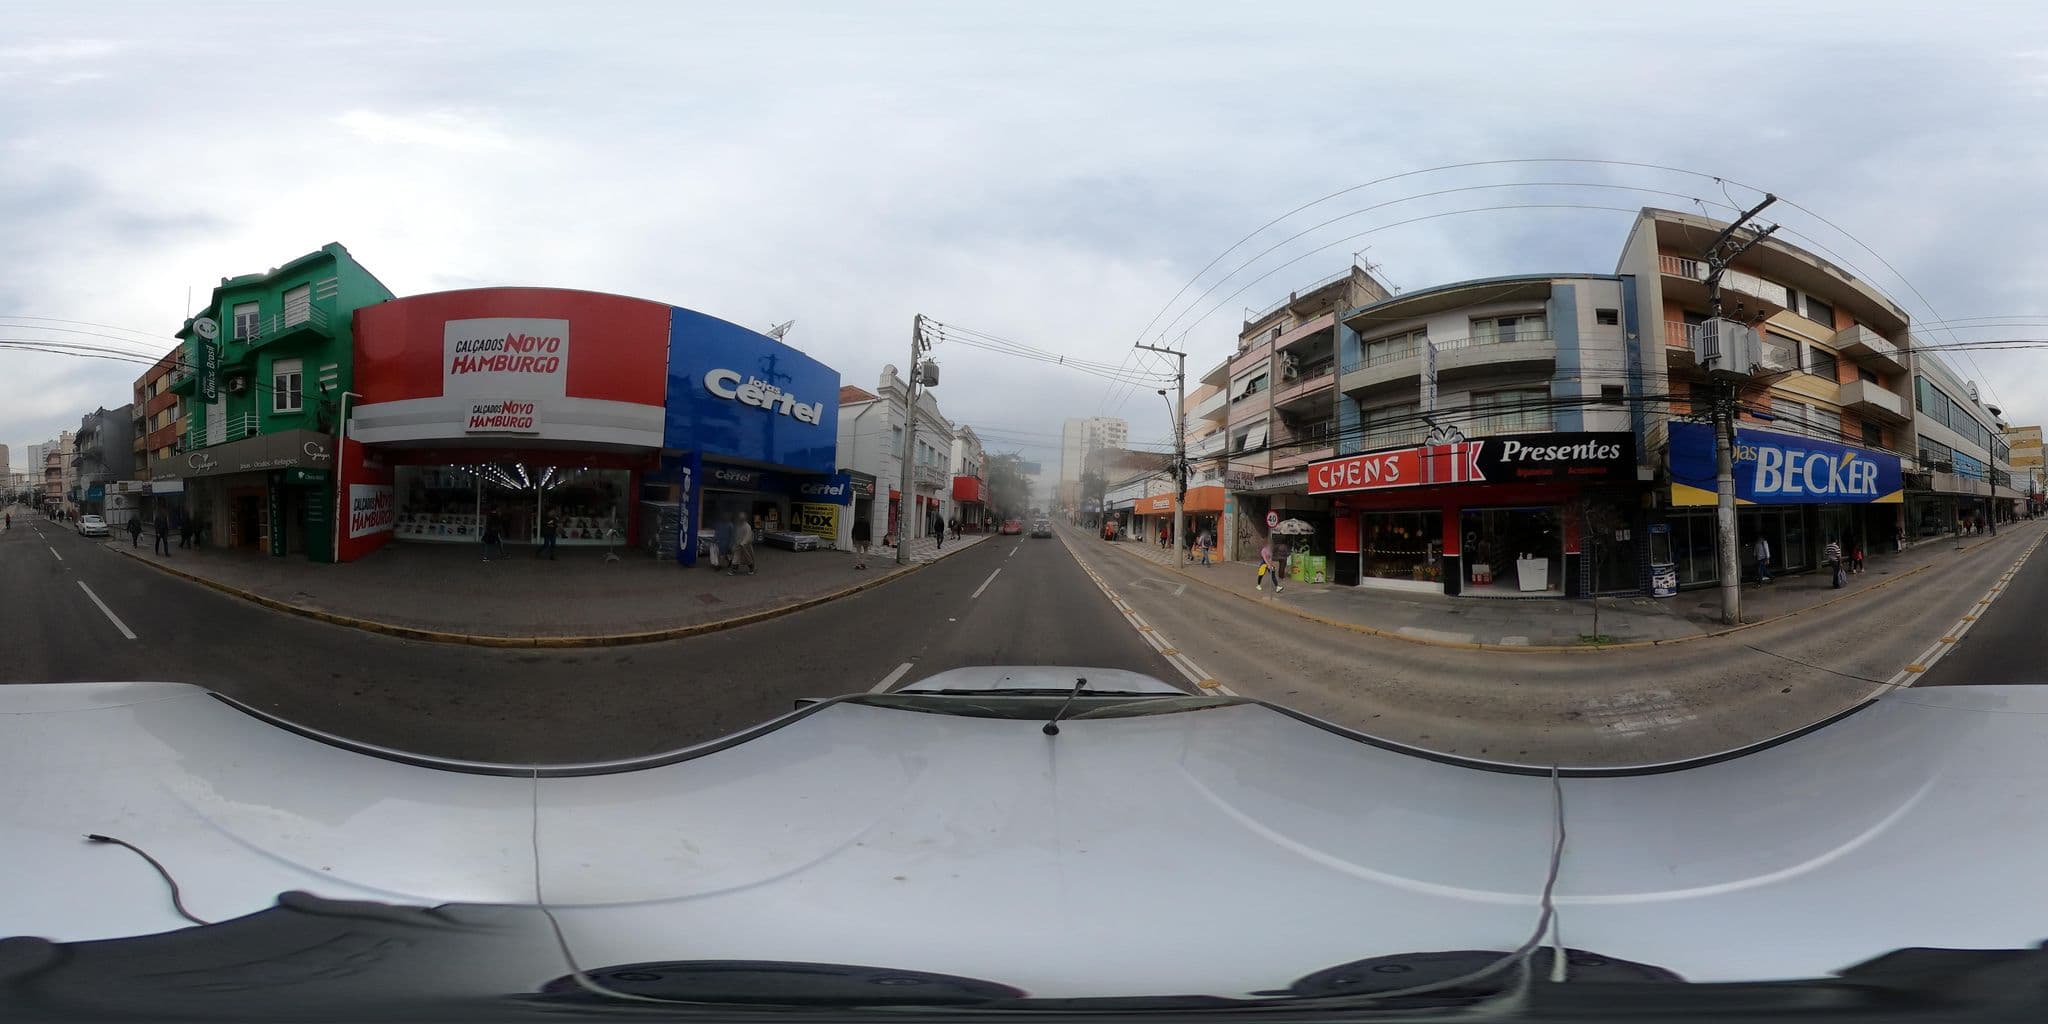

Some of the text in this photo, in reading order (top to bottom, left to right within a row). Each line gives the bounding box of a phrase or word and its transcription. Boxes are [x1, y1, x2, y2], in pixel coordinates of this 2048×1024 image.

[456, 332, 561, 354] CALÇADOS NOVO
[451, 354, 560, 375] HAMBURGO
[748, 375, 782, 394] lojas
[704, 368, 824, 426] Certel
[472, 400, 534, 415] CALÇADOS NOVO
[469, 415, 534, 428] HAMBURGO
[1500, 440, 1621, 462] Presentes
[715, 469, 752, 483] Certel
[1318, 455, 1401, 489] CHENS
[1754, 446, 1878, 495] BECKER
[801, 482, 845, 496] Certel
[680, 466, 692, 551] Certel
[804, 514, 833, 528] 10X
[1267, 515, 1277, 523] 40
